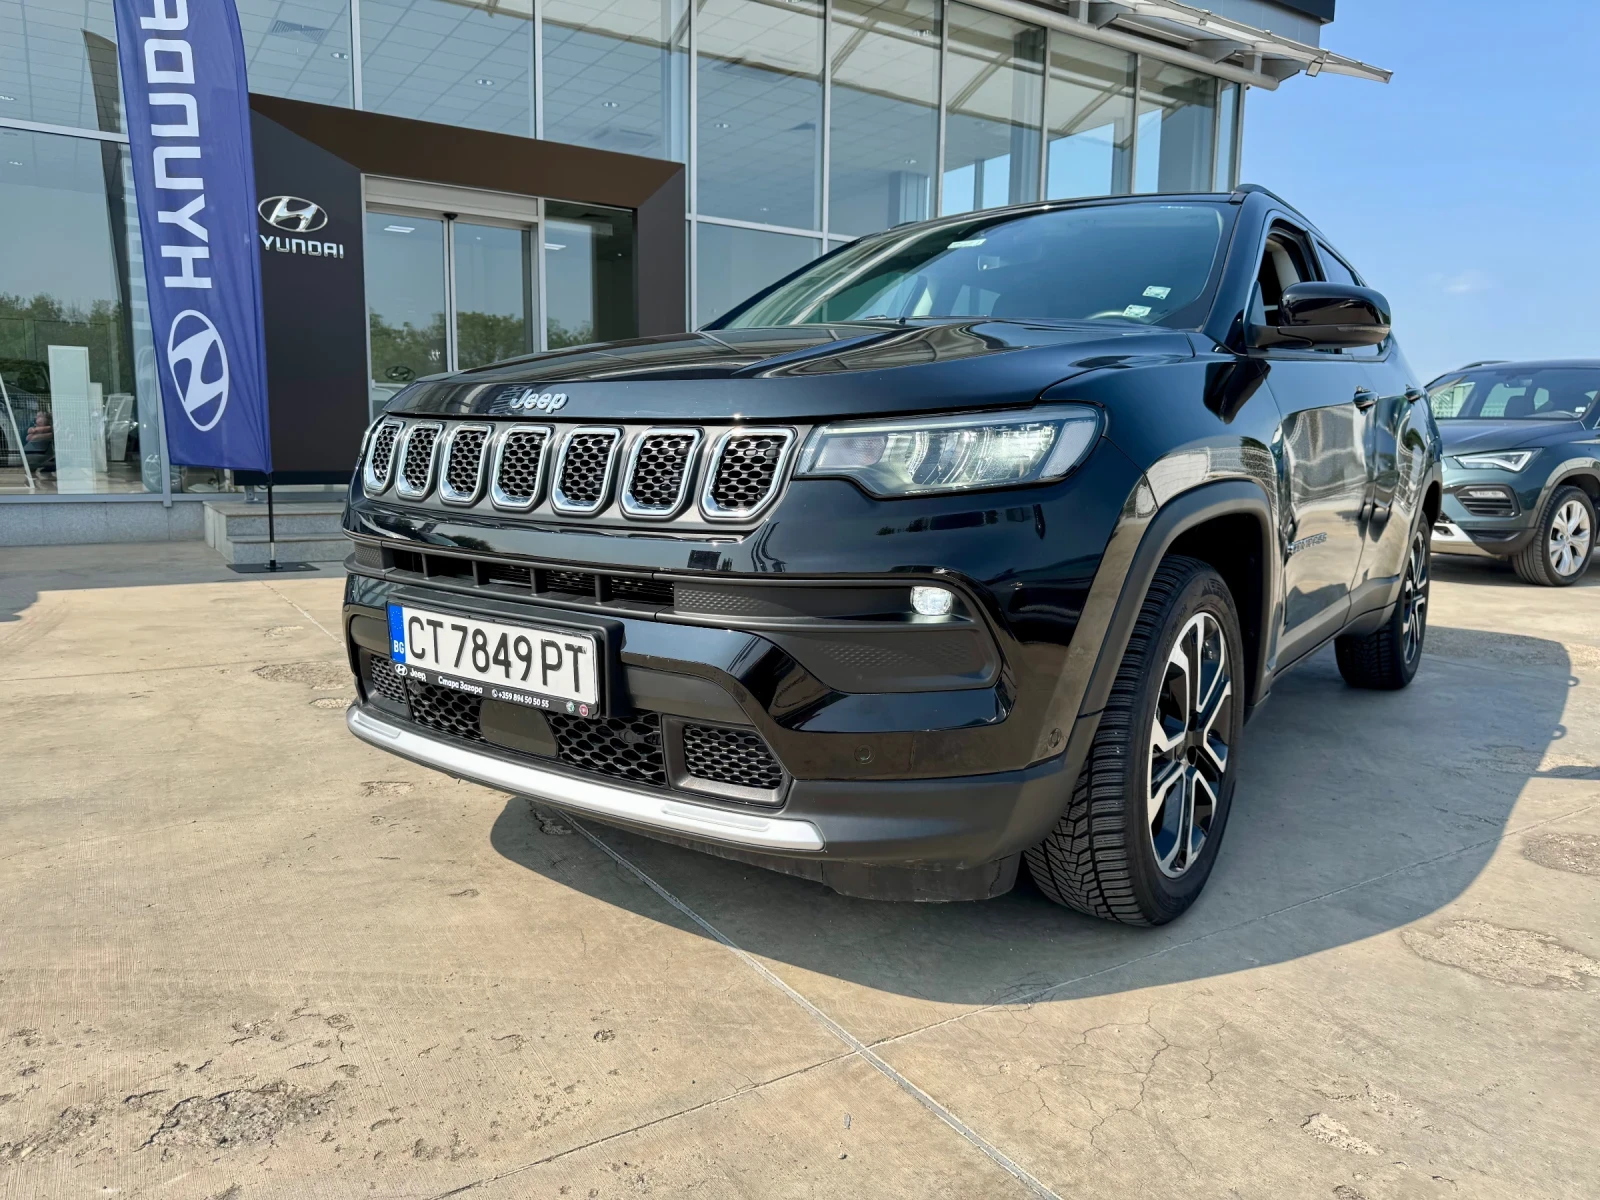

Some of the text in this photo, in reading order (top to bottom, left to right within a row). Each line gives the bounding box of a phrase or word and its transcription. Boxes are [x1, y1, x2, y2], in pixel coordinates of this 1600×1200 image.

[259, 234, 345, 259] YUNDAI
[509, 388, 569, 414] Jeep
[393, 640, 405, 654] BG
[409, 668, 427, 682] Jeep
[498, 691, 512, 700] +359
